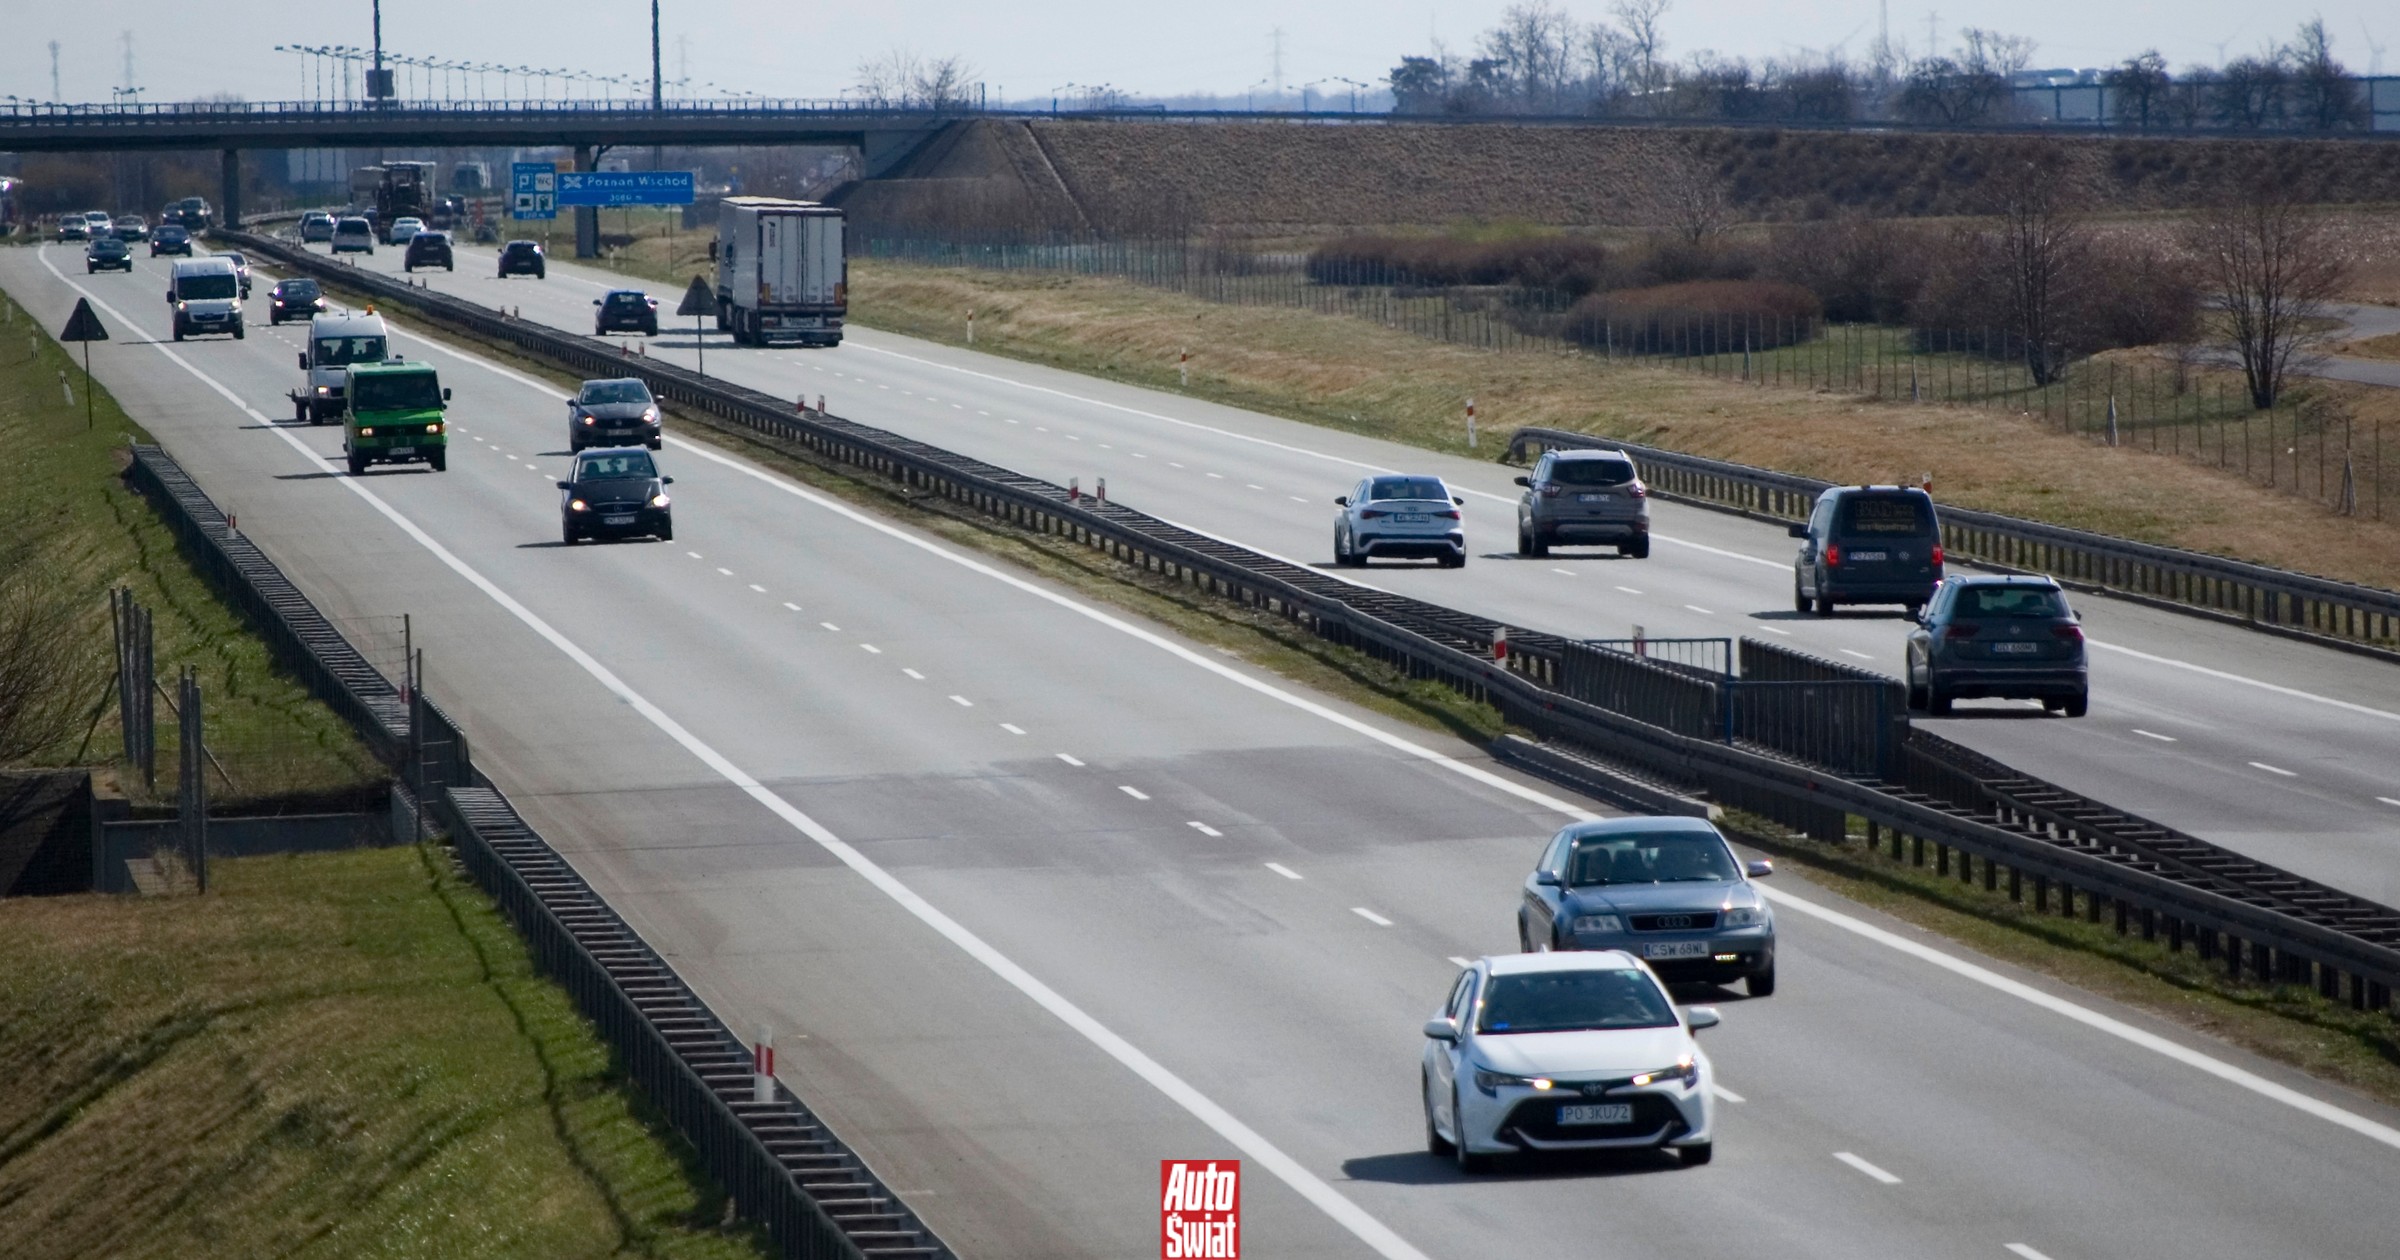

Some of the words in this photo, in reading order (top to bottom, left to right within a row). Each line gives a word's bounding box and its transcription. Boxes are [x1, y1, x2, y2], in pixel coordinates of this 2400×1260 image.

[1650, 944, 1677, 957] CSW
[1565, 1107, 1582, 1120] PO
[1588, 1105, 1629, 1120] 3KU72
